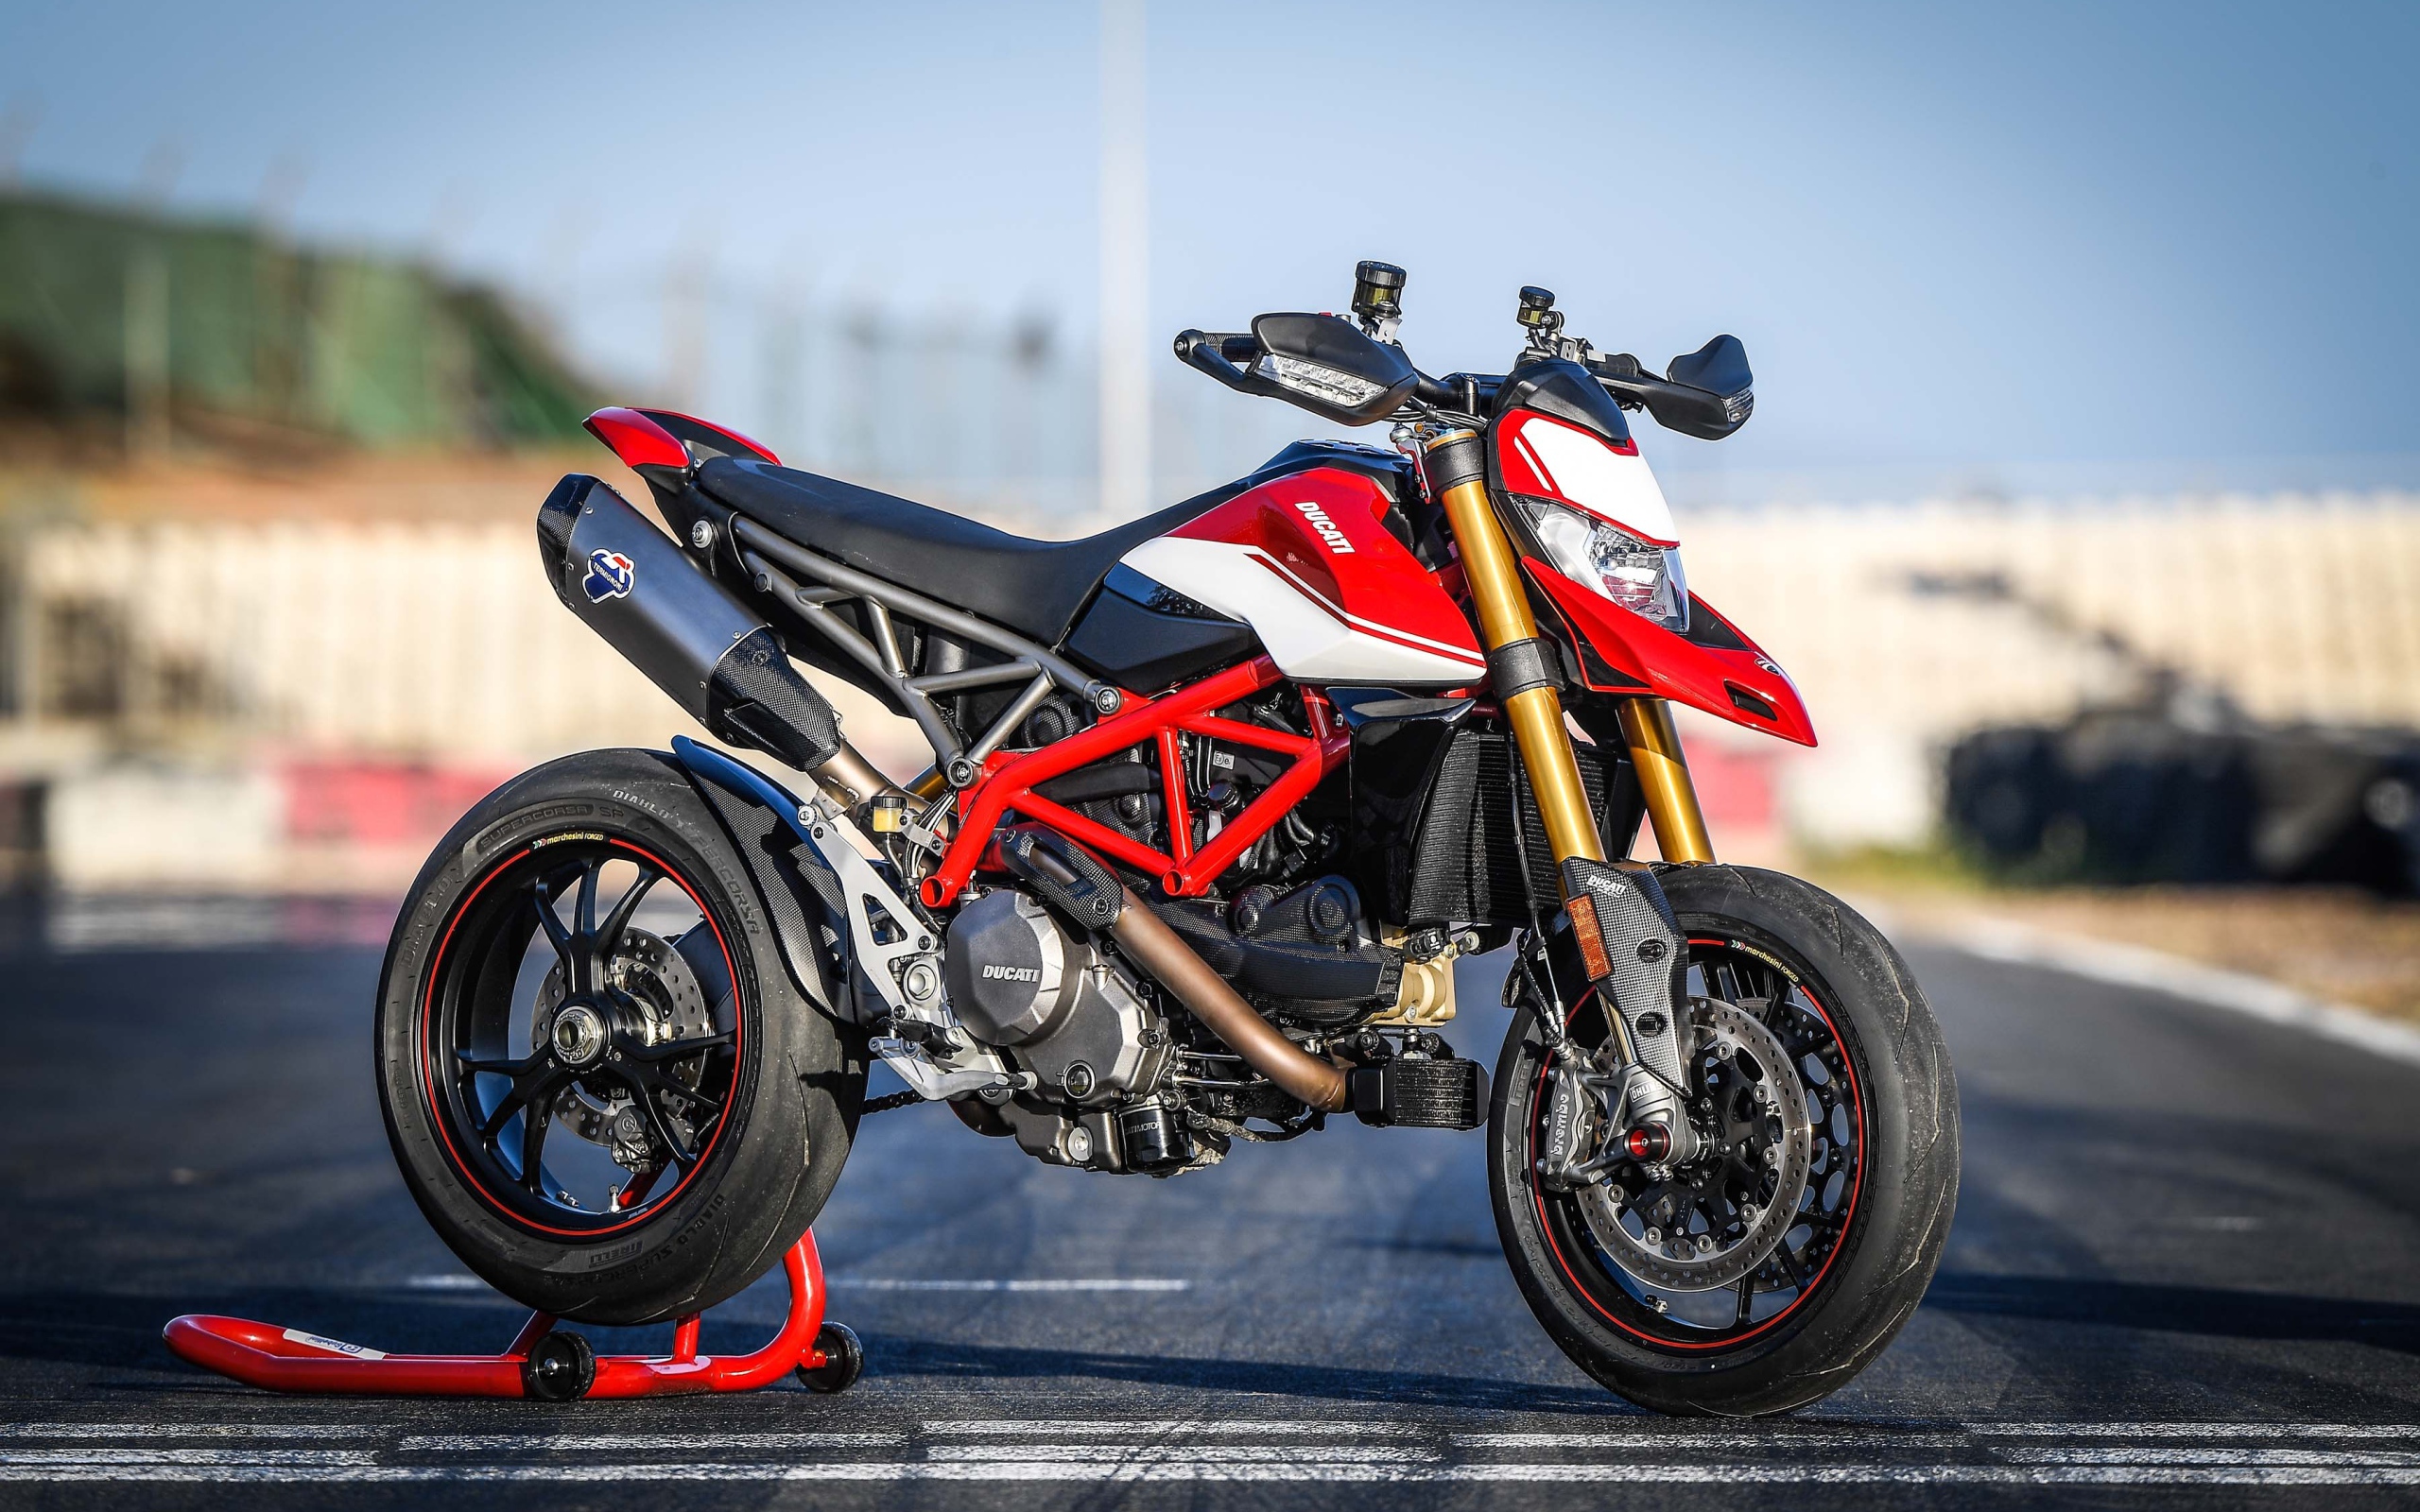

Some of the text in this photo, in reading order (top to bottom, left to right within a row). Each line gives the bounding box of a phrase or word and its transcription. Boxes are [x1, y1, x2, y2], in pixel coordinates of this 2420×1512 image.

[1294, 501, 1356, 554] DUCATI
[594, 561, 623, 592] TERMIGNONI
[480, 805, 588, 849] SUPERCORSA
[599, 806, 624, 819] SP
[547, 832, 604, 845] marchesini FORGED
[1587, 874, 1627, 895] DUCATI
[982, 964, 1041, 983] DUCATI
[1744, 946, 1799, 983] marchesini FORGED
[1550, 1093, 1570, 1156] brembo
[588, 1239, 644, 1269] PIRELLI
